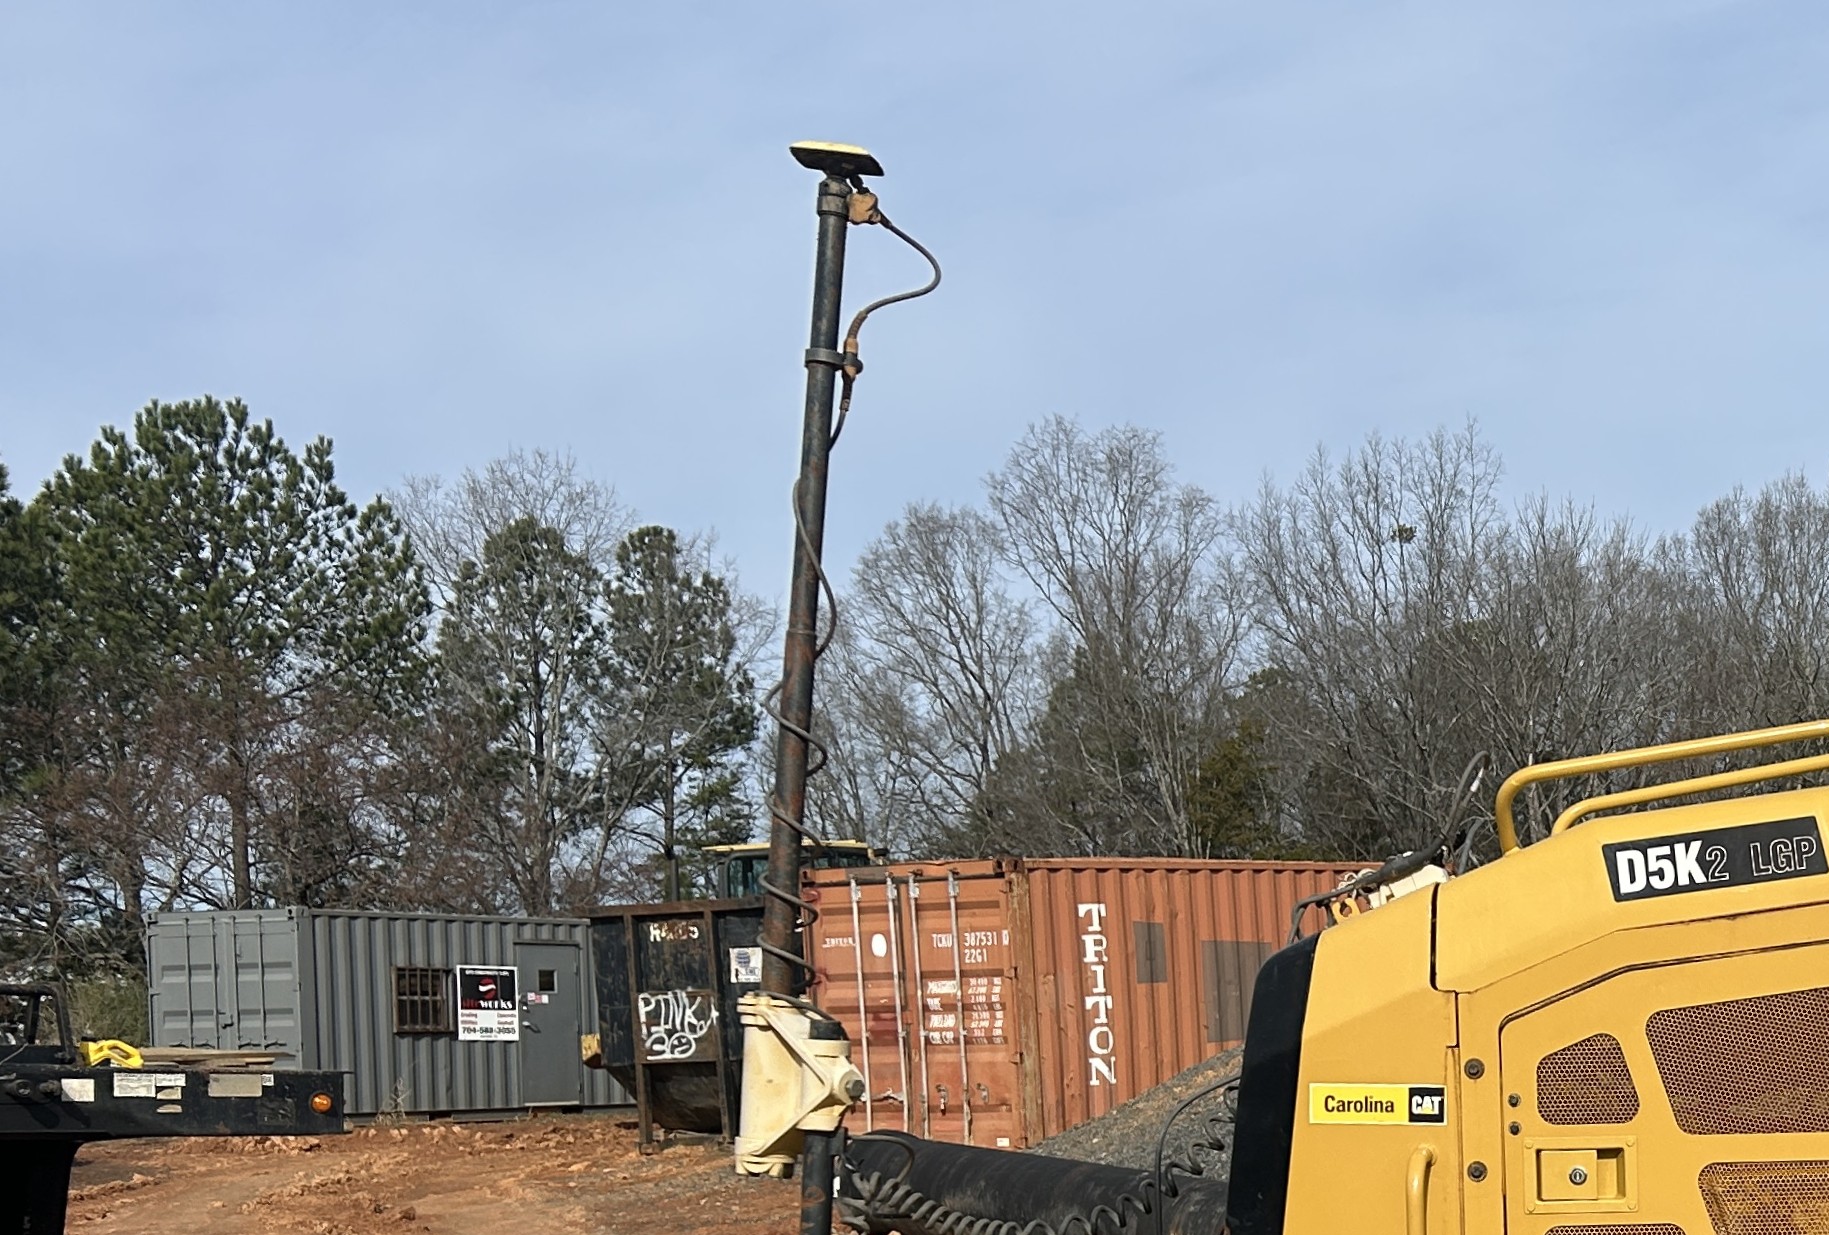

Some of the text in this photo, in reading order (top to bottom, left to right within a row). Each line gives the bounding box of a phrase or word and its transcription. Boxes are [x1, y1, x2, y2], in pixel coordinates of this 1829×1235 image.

[1615, 836, 1817, 894] D5K2 LGP
[963, 931, 998, 947] 387531
[964, 948, 987, 964] 22G1
[1077, 903, 1117, 1086] TRITON
[1324, 1095, 1442, 1115] Carolina CAT
